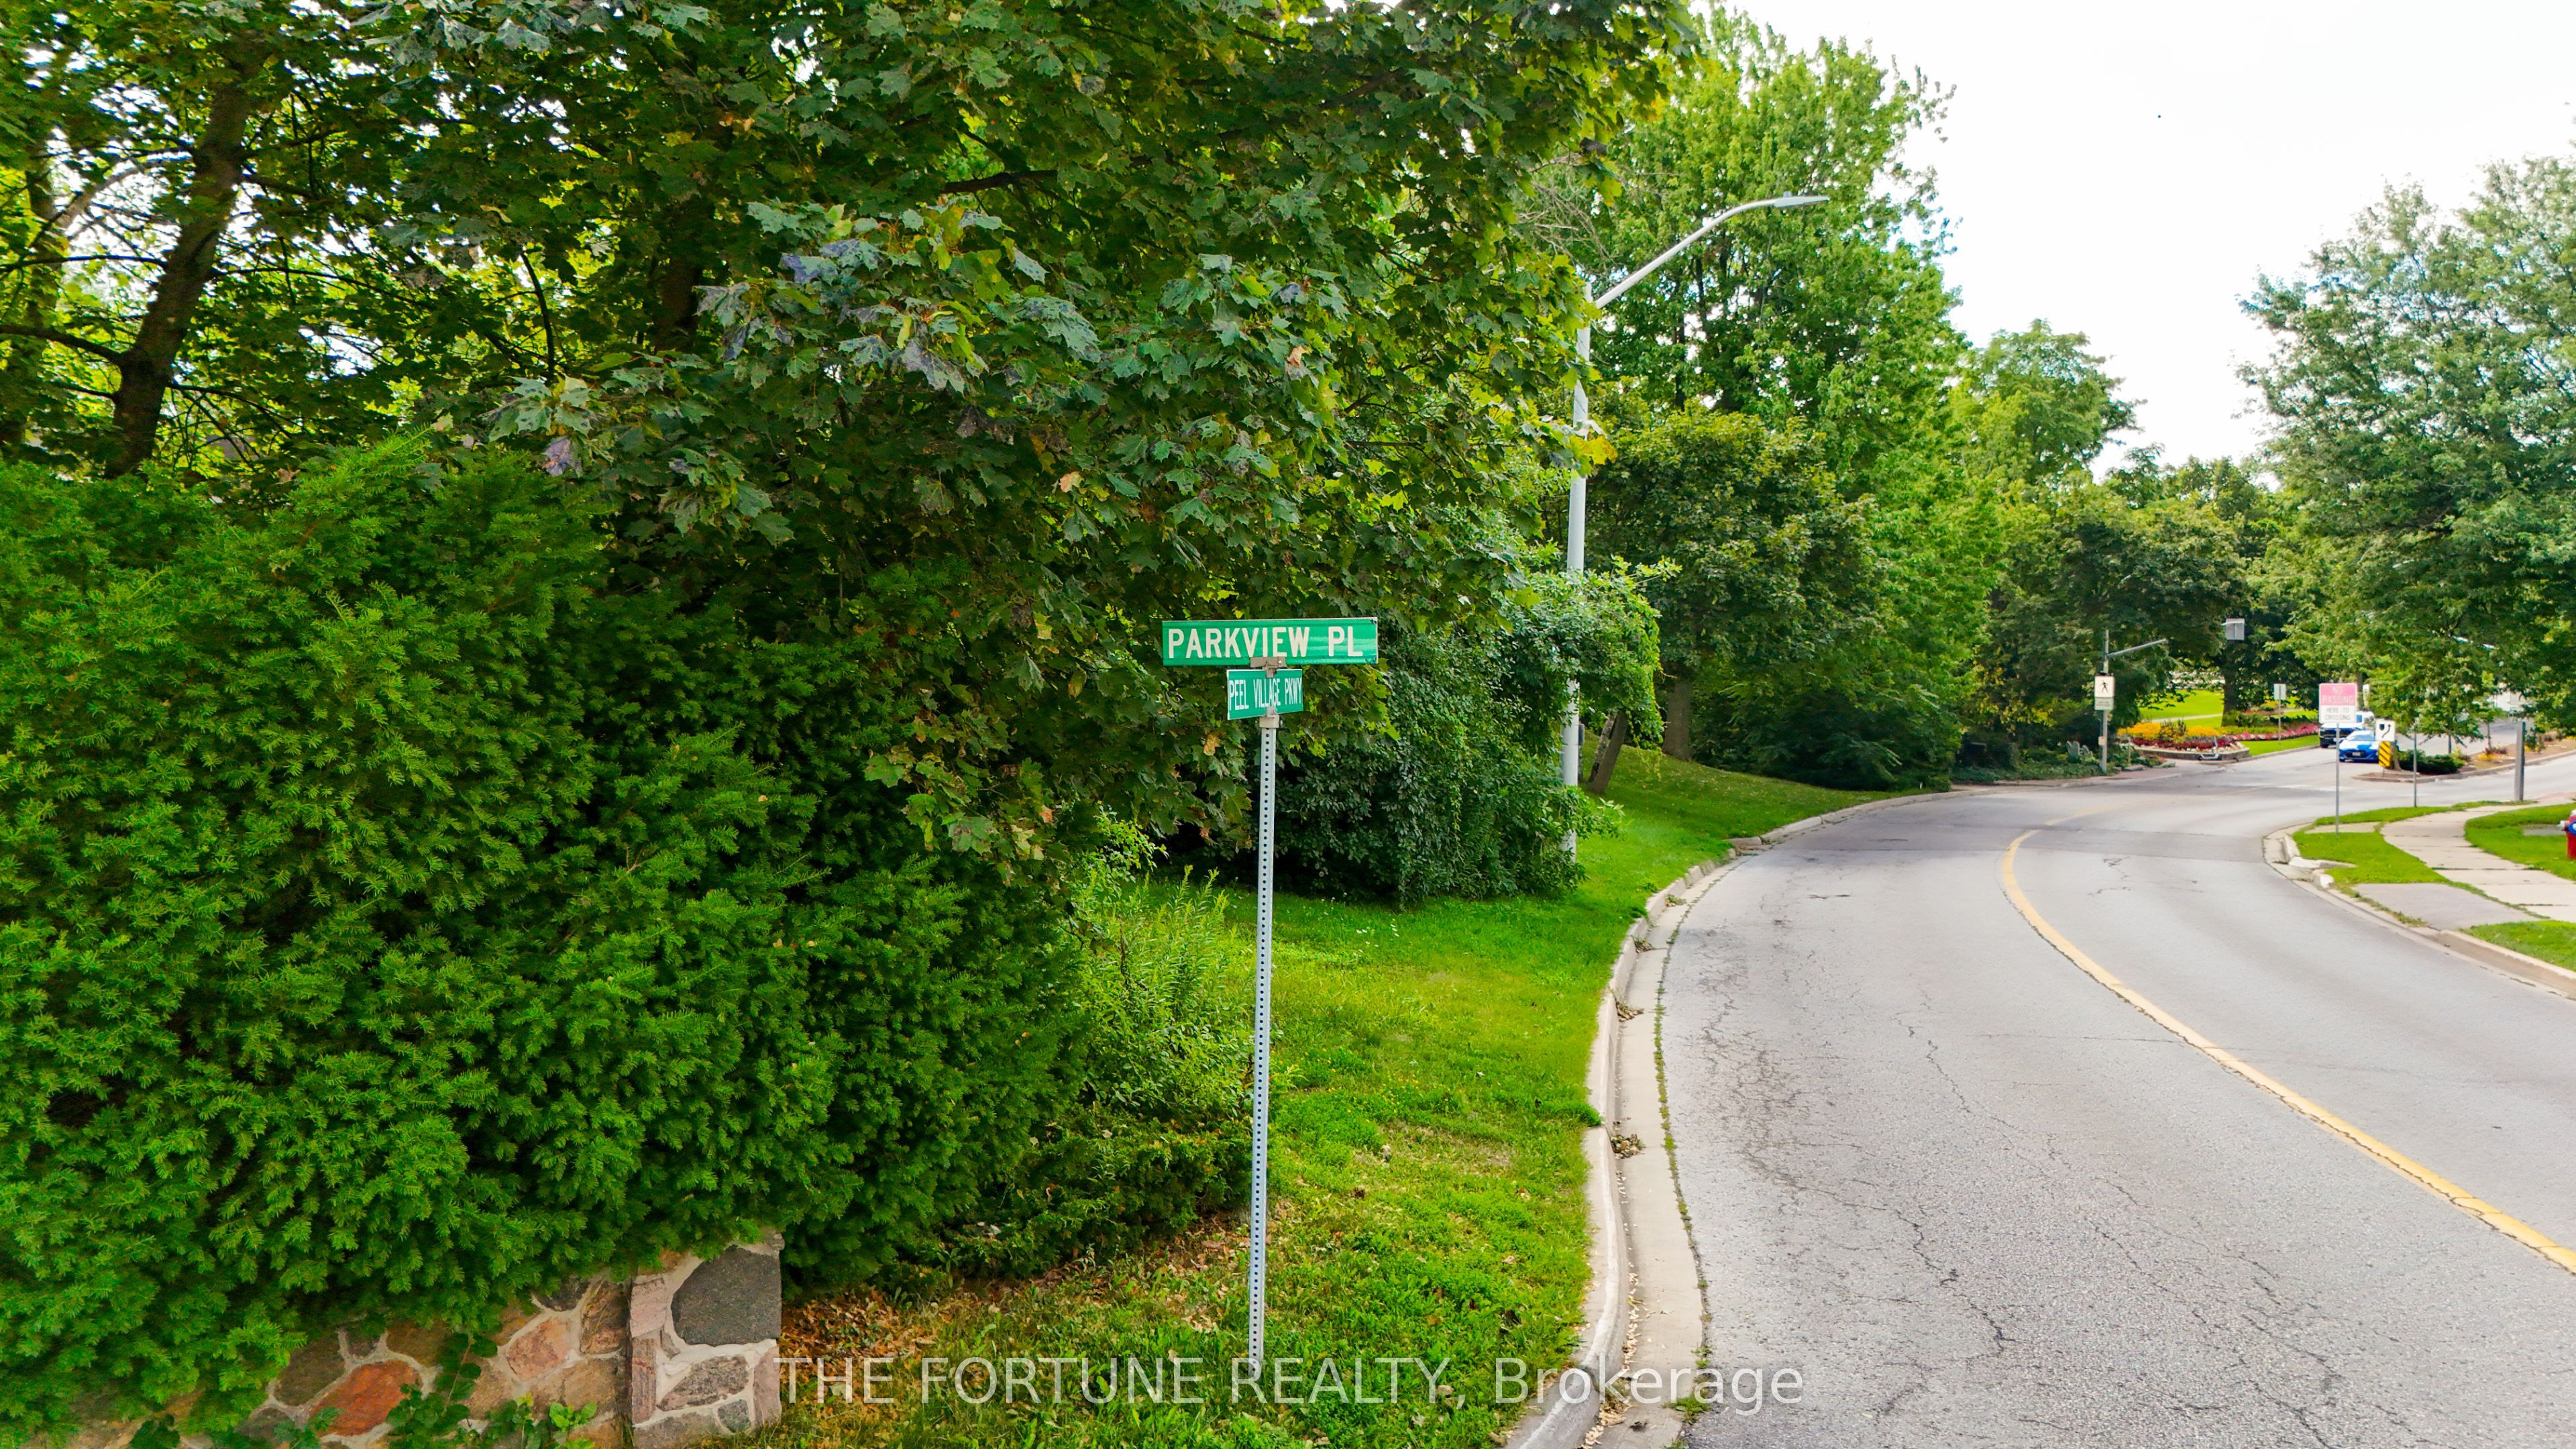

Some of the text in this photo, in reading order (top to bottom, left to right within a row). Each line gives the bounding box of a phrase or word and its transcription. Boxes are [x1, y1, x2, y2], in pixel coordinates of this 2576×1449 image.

[1169, 626, 1363, 659] PARKVIEW PL
[1229, 677, 1302, 710] PEEL VILLAGE PKWY
[2322, 695, 2354, 704] PASSING
[2333, 686, 2343, 695] NO
